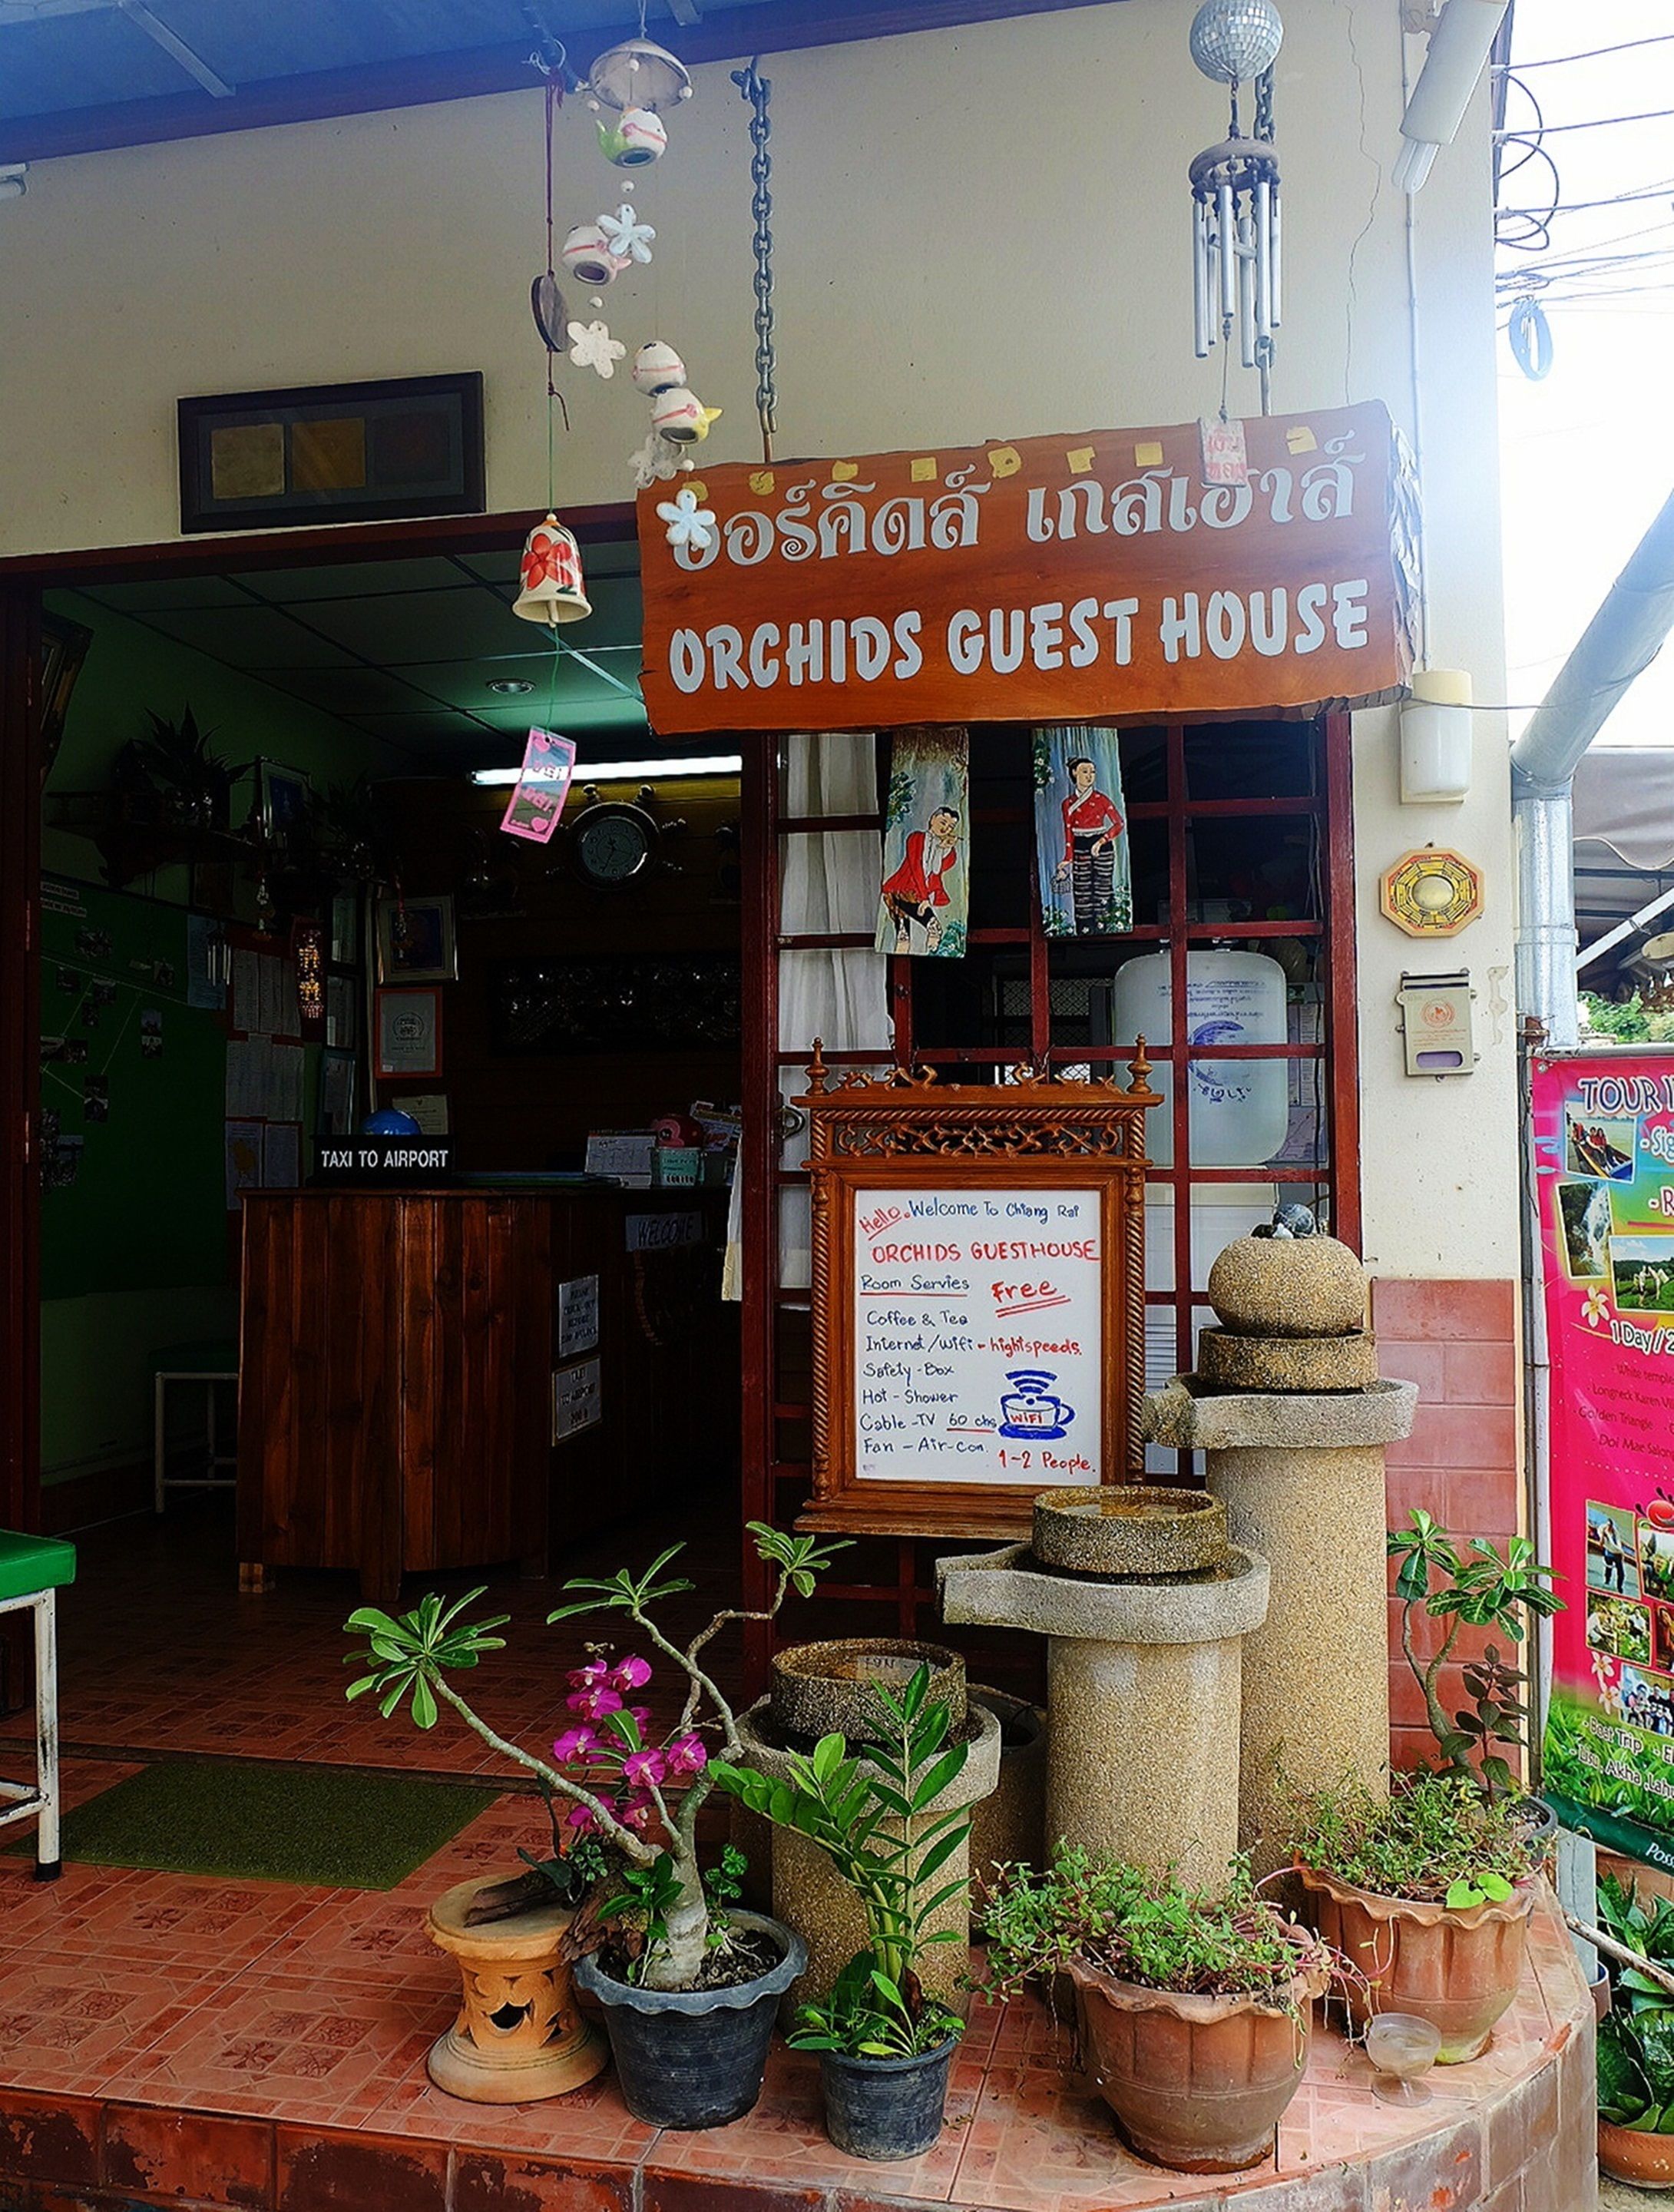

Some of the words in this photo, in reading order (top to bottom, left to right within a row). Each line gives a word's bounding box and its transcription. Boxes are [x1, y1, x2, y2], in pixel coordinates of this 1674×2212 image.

[668, 611, 923, 694] ORCHIDS
[948, 597, 1140, 676] GUEST
[1160, 578, 1369, 664] HOUSE
[1579, 1077, 1662, 1114] TOUR
[321, 1150, 352, 1168] TAXI
[358, 1150, 378, 1168] TO
[383, 1150, 448, 1168] AIRPORT
[909, 1197, 978, 1217] Welcome
[984, 1200, 998, 1217] To
[1006, 1202, 1048, 1225] Chiang
[1057, 1204, 1080, 1218] Rai
[872, 1243, 961, 1263] ORCHIDS
[971, 1239, 1100, 1261] GUESTHOUSE
[861, 1274, 902, 1290] Room
[911, 1274, 970, 1290] Servies
[991, 1280, 1057, 1303] Free
[867, 1310, 917, 1326] Coffee
[921, 1313, 935, 1327] &
[940, 1310, 968, 1325] Tea
[866, 1333, 925, 1352] Internet
[862, 1388, 887, 1405] Hot
[904, 1389, 959, 1405] Shower
[860, 1412, 907, 1431] Cable
[948, 1413, 968, 1426] 60
[864, 1437, 894, 1454] Fan
[1615, 1727, 1643, 1756] Trip
